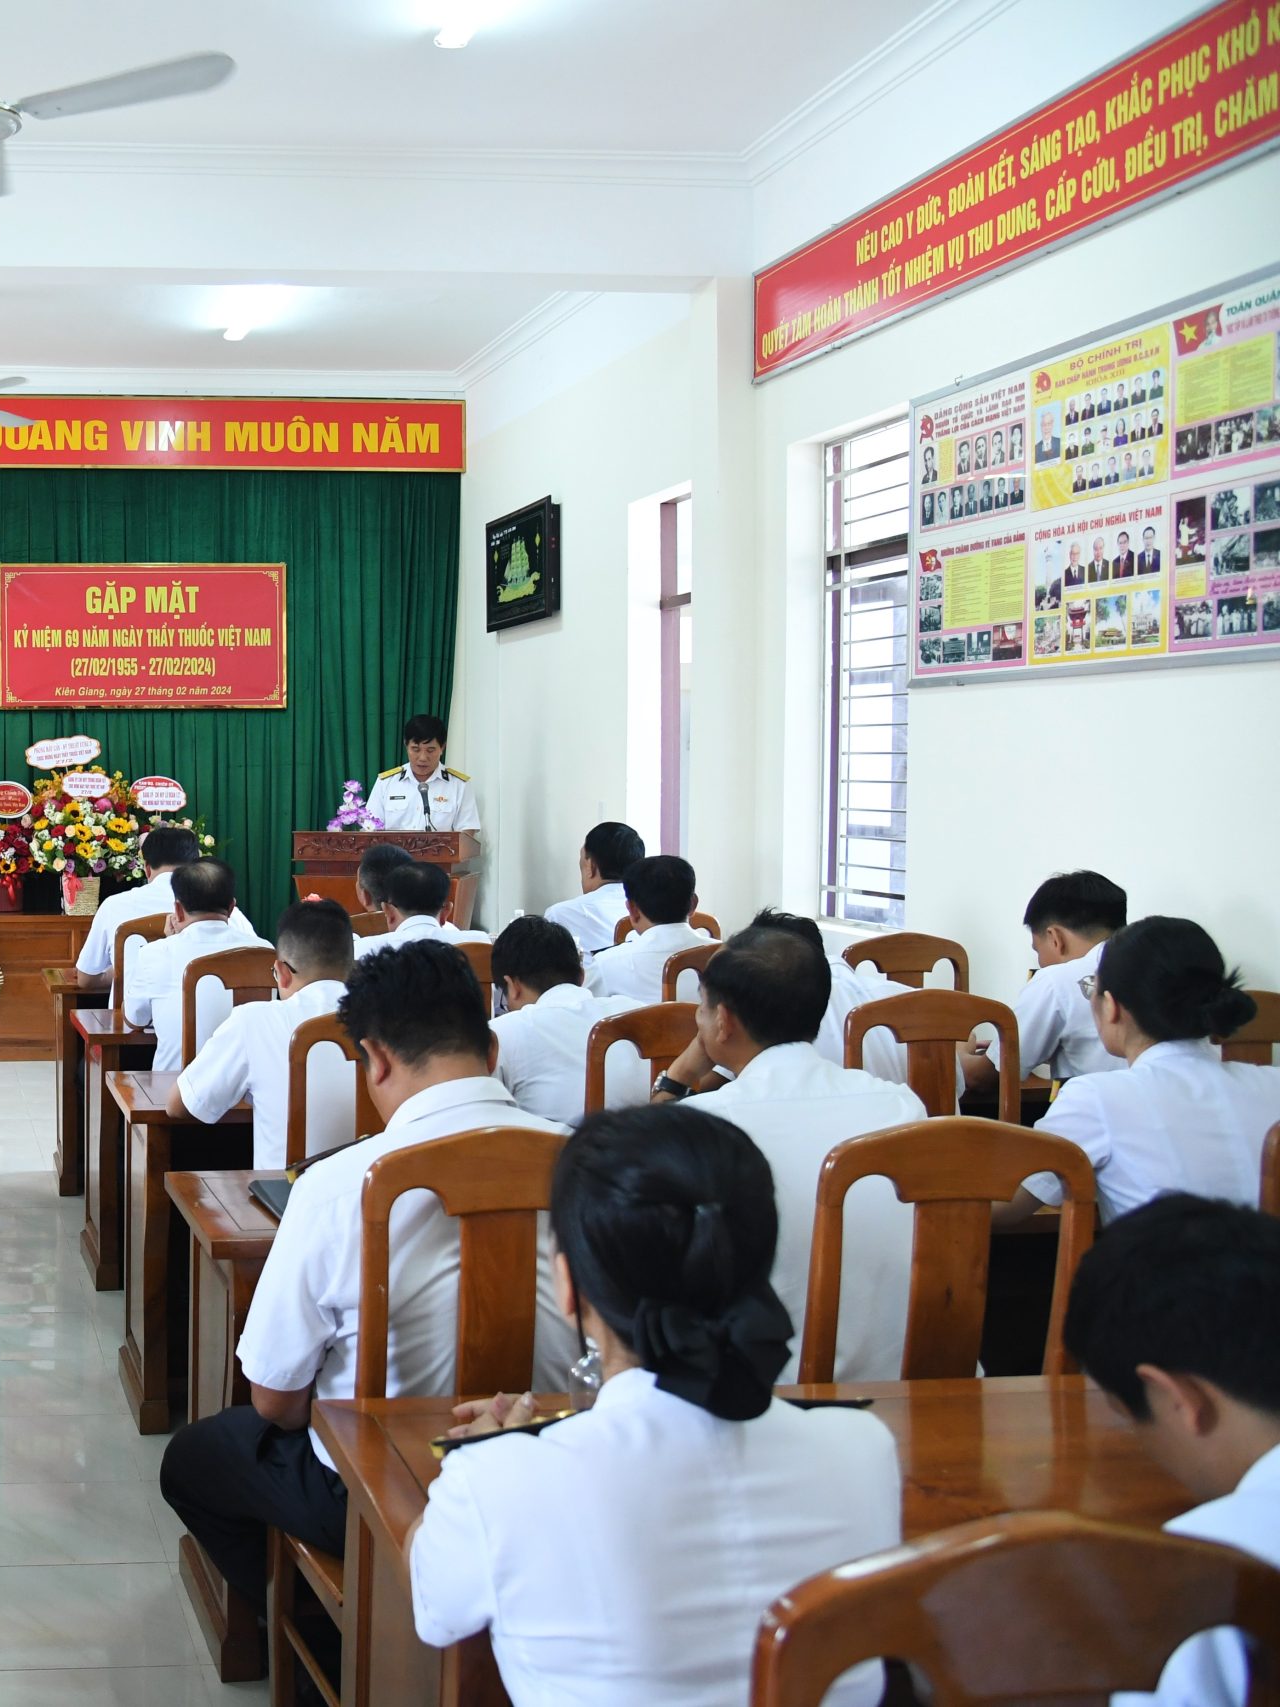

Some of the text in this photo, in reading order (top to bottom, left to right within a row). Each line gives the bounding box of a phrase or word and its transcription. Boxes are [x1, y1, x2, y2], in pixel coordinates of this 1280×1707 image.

[856, 229, 878, 266] NÊU
[880, 216, 903, 253] CAO
[906, 211, 914, 239] Y
[916, 195, 946, 236] ĐỨC,
[948, 171, 985, 218] ĐOÀN
[988, 148, 1017, 198] KẾT,
[1020, 129, 1061, 179] SÁNG
[1065, 109, 1101, 157] TẠO,
[1105, 71, 1153, 134] KHẮC
[1158, 44, 1211, 105] PHỤC
[1216, 8, 1261, 74] KHÓ
[762, 71, 1278, 359] QUYẾT TÂM HOÀN THÀNH TỐT NHIỆM VỤ THU DUNG, CẤP CỨU, ĐIỀU TRỊ, CHĂM
[121, 421, 211, 452] VINH
[225, 416, 339, 453] MUÔN
[352, 416, 440, 454] NĂM
[1034, 528, 1051, 543] CỘNG
[1128, 508, 1143, 523] VIỆT
[1145, 505, 1162, 519] NAM
[86, 580, 200, 620] GẶP MẶT
[14, 622, 271, 652] KỶ NIỆM 69 NĂM NGÀY THẦY THUỐC VIỆT NAM
[71, 657, 138, 678] (27/02/1955
[149, 657, 216, 677] 27/02/2024)
[55, 686, 232, 698] Kiên Giang, ngày 27 tháng 02 năm 2024
